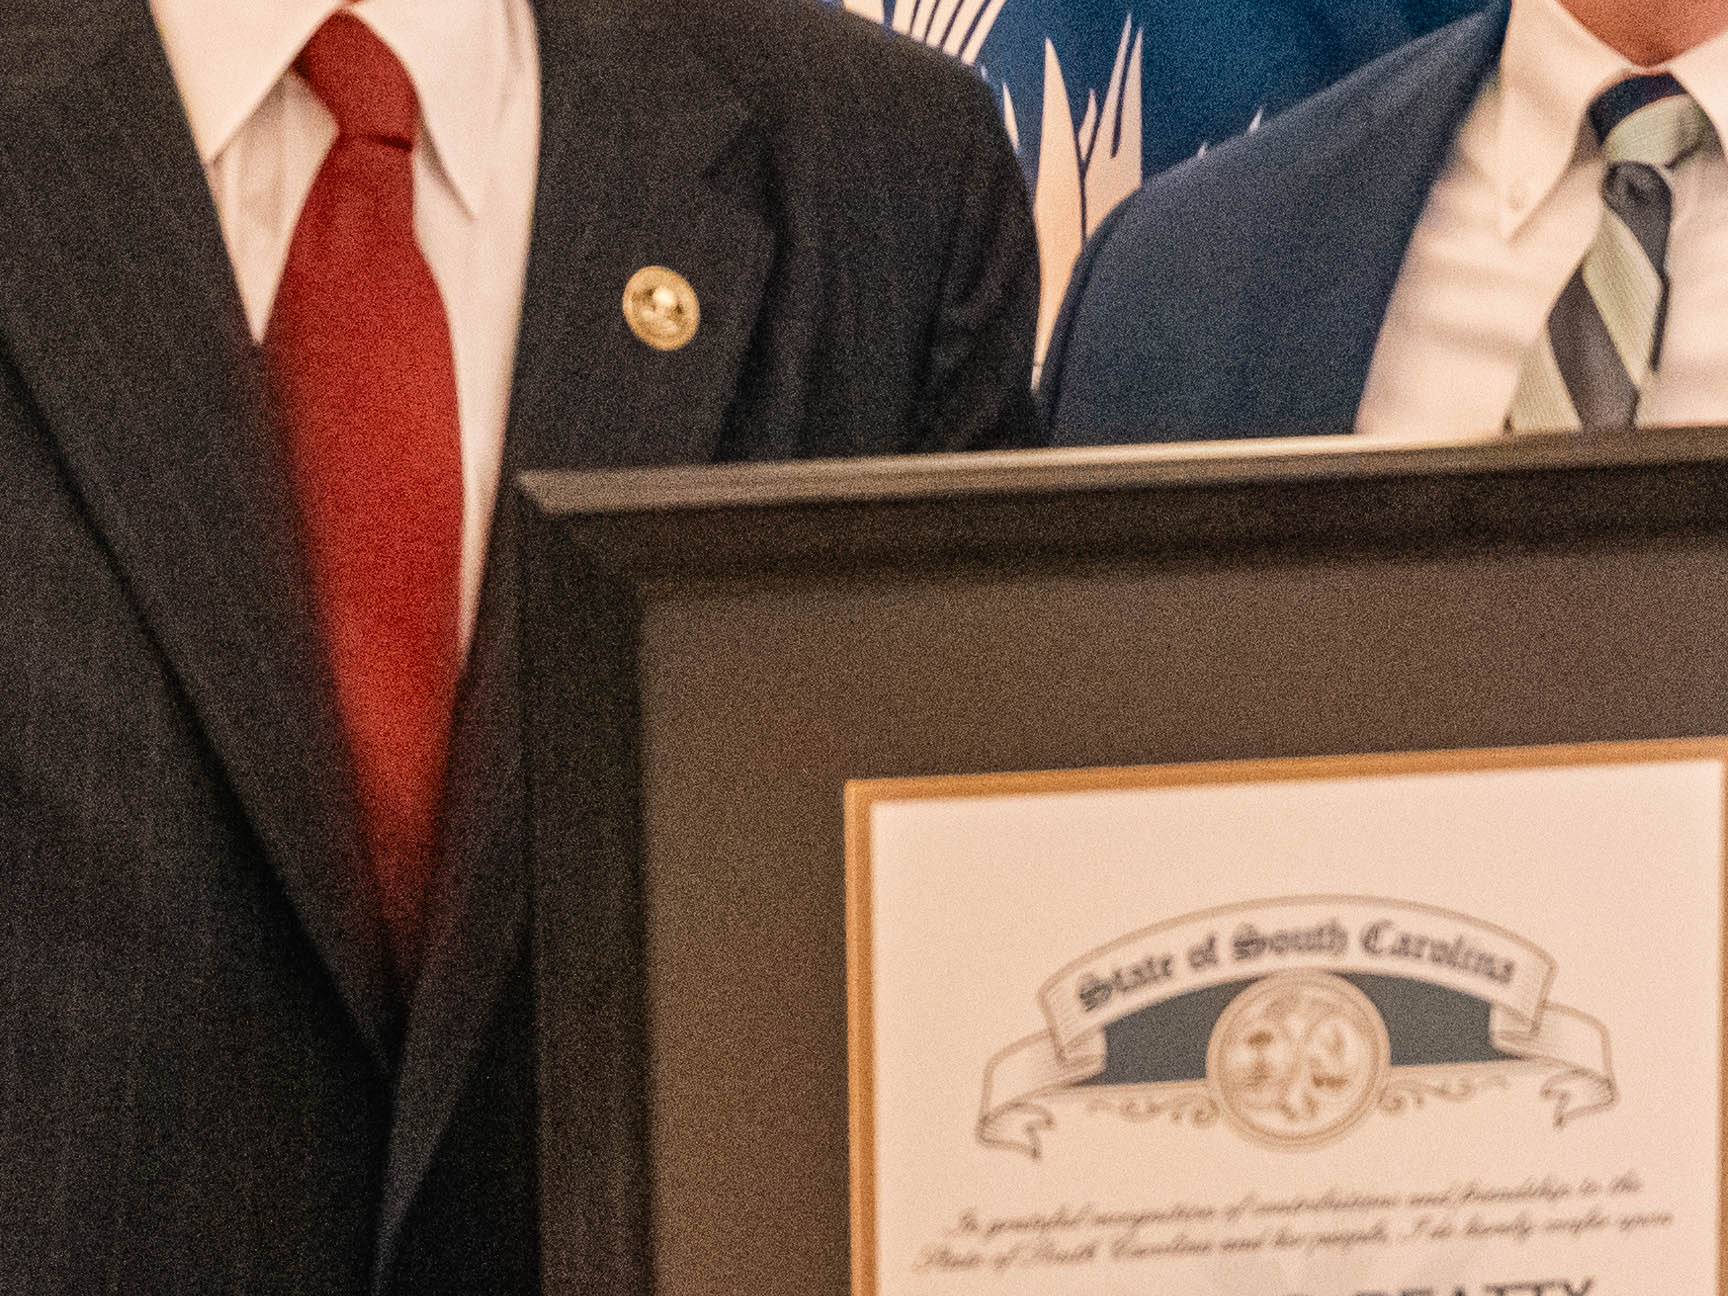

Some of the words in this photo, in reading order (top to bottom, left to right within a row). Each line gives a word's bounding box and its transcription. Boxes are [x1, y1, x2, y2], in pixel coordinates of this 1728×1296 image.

[1077, 951, 1174, 1012] State
[1187, 933, 1219, 972] of
[1231, 917, 1350, 963] South
[1360, 917, 1516, 984] Carolina
